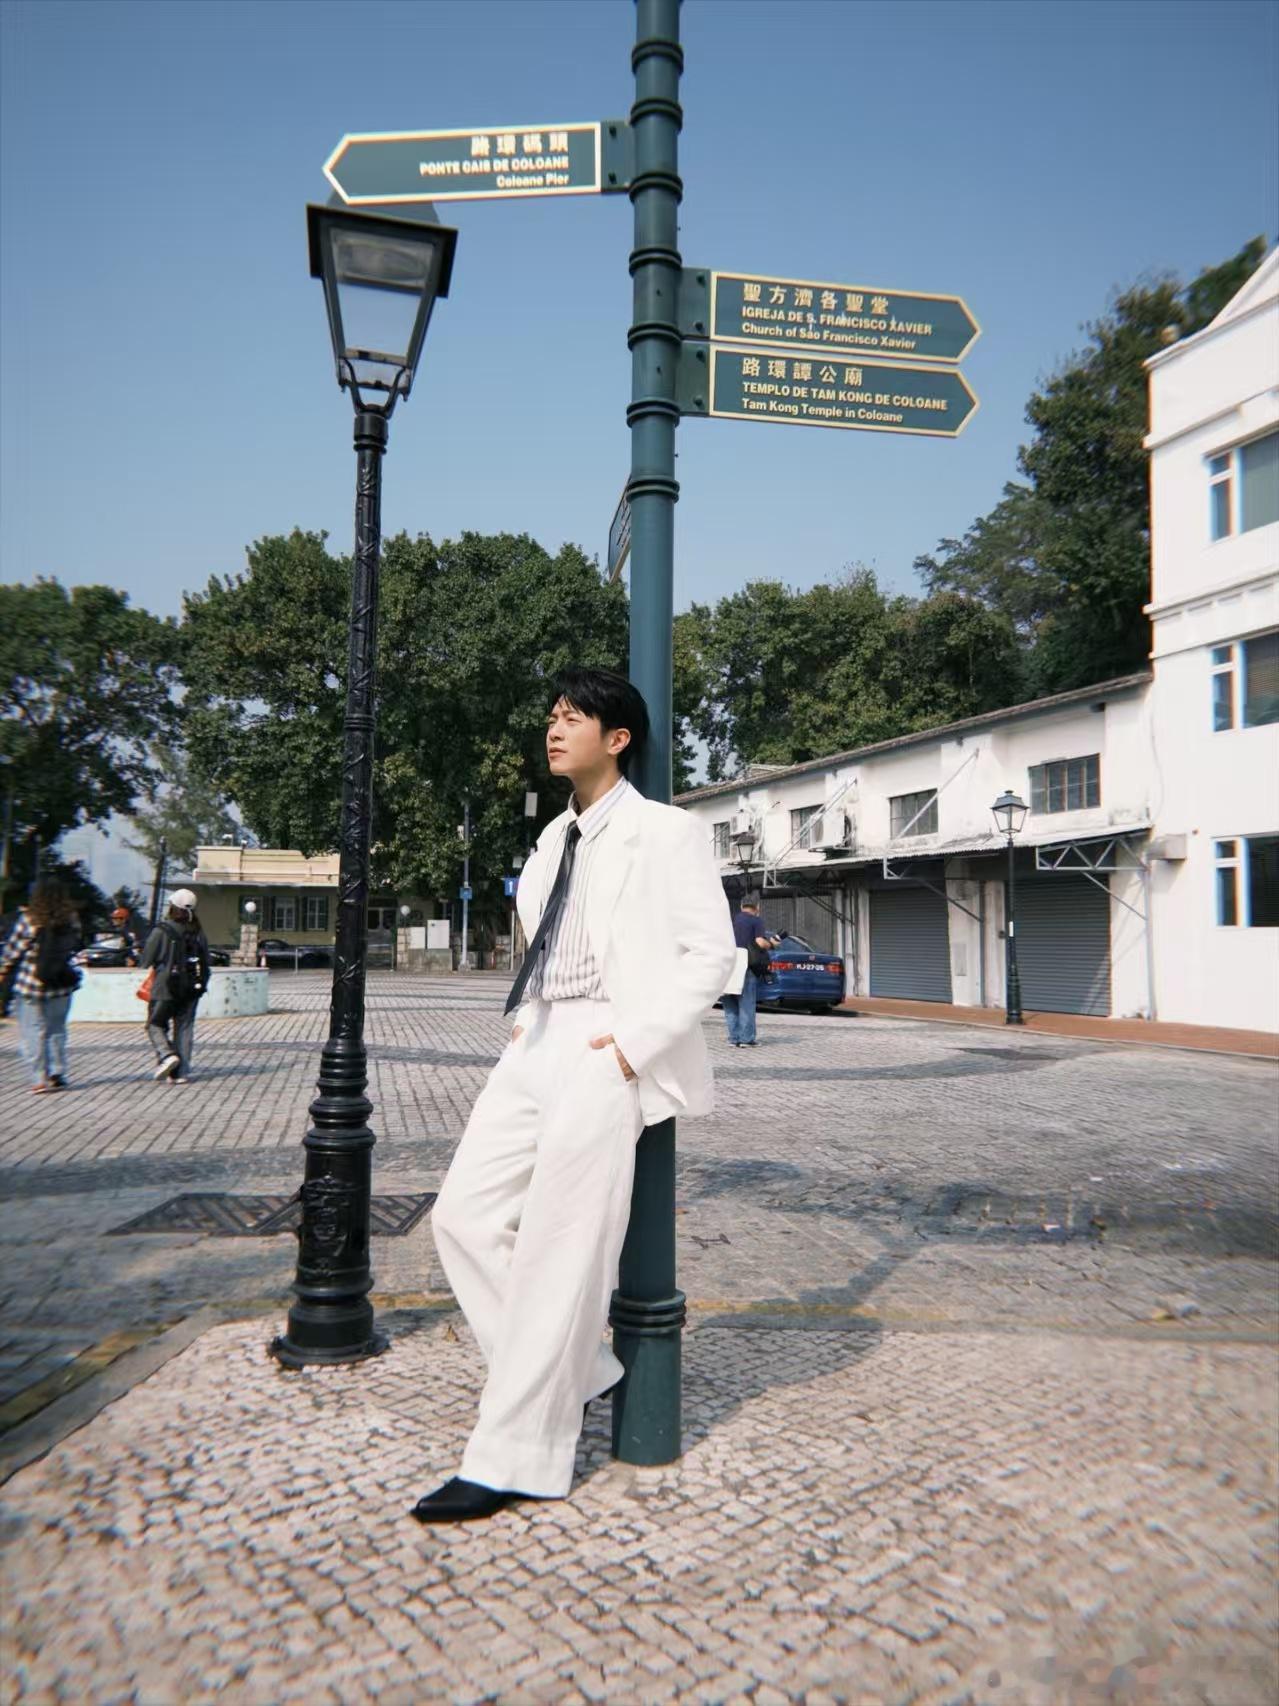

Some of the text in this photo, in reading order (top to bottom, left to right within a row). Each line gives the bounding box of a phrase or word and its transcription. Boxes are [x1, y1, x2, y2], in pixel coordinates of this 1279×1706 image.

[419, 155, 569, 176] PONTE CAIS DE COLOANE
[496, 172, 569, 187] Coloane Pier
[743, 282, 888, 315] 聖方濟各聖堂
[742, 306, 932, 335] IGREJA DE S. FRANCISCO XAVIER
[742, 322, 783, 336] Church
[785, 326, 797, 337] of
[823, 331, 878, 346] Francisco
[880, 336, 917, 350] Xavier
[742, 357, 863, 386] 路環譚公廟
[743, 381, 948, 410] TEMPLO DE TAM KONG DE COLOANE
[743, 398, 903, 423] Tam Kong Temple in Coloane
